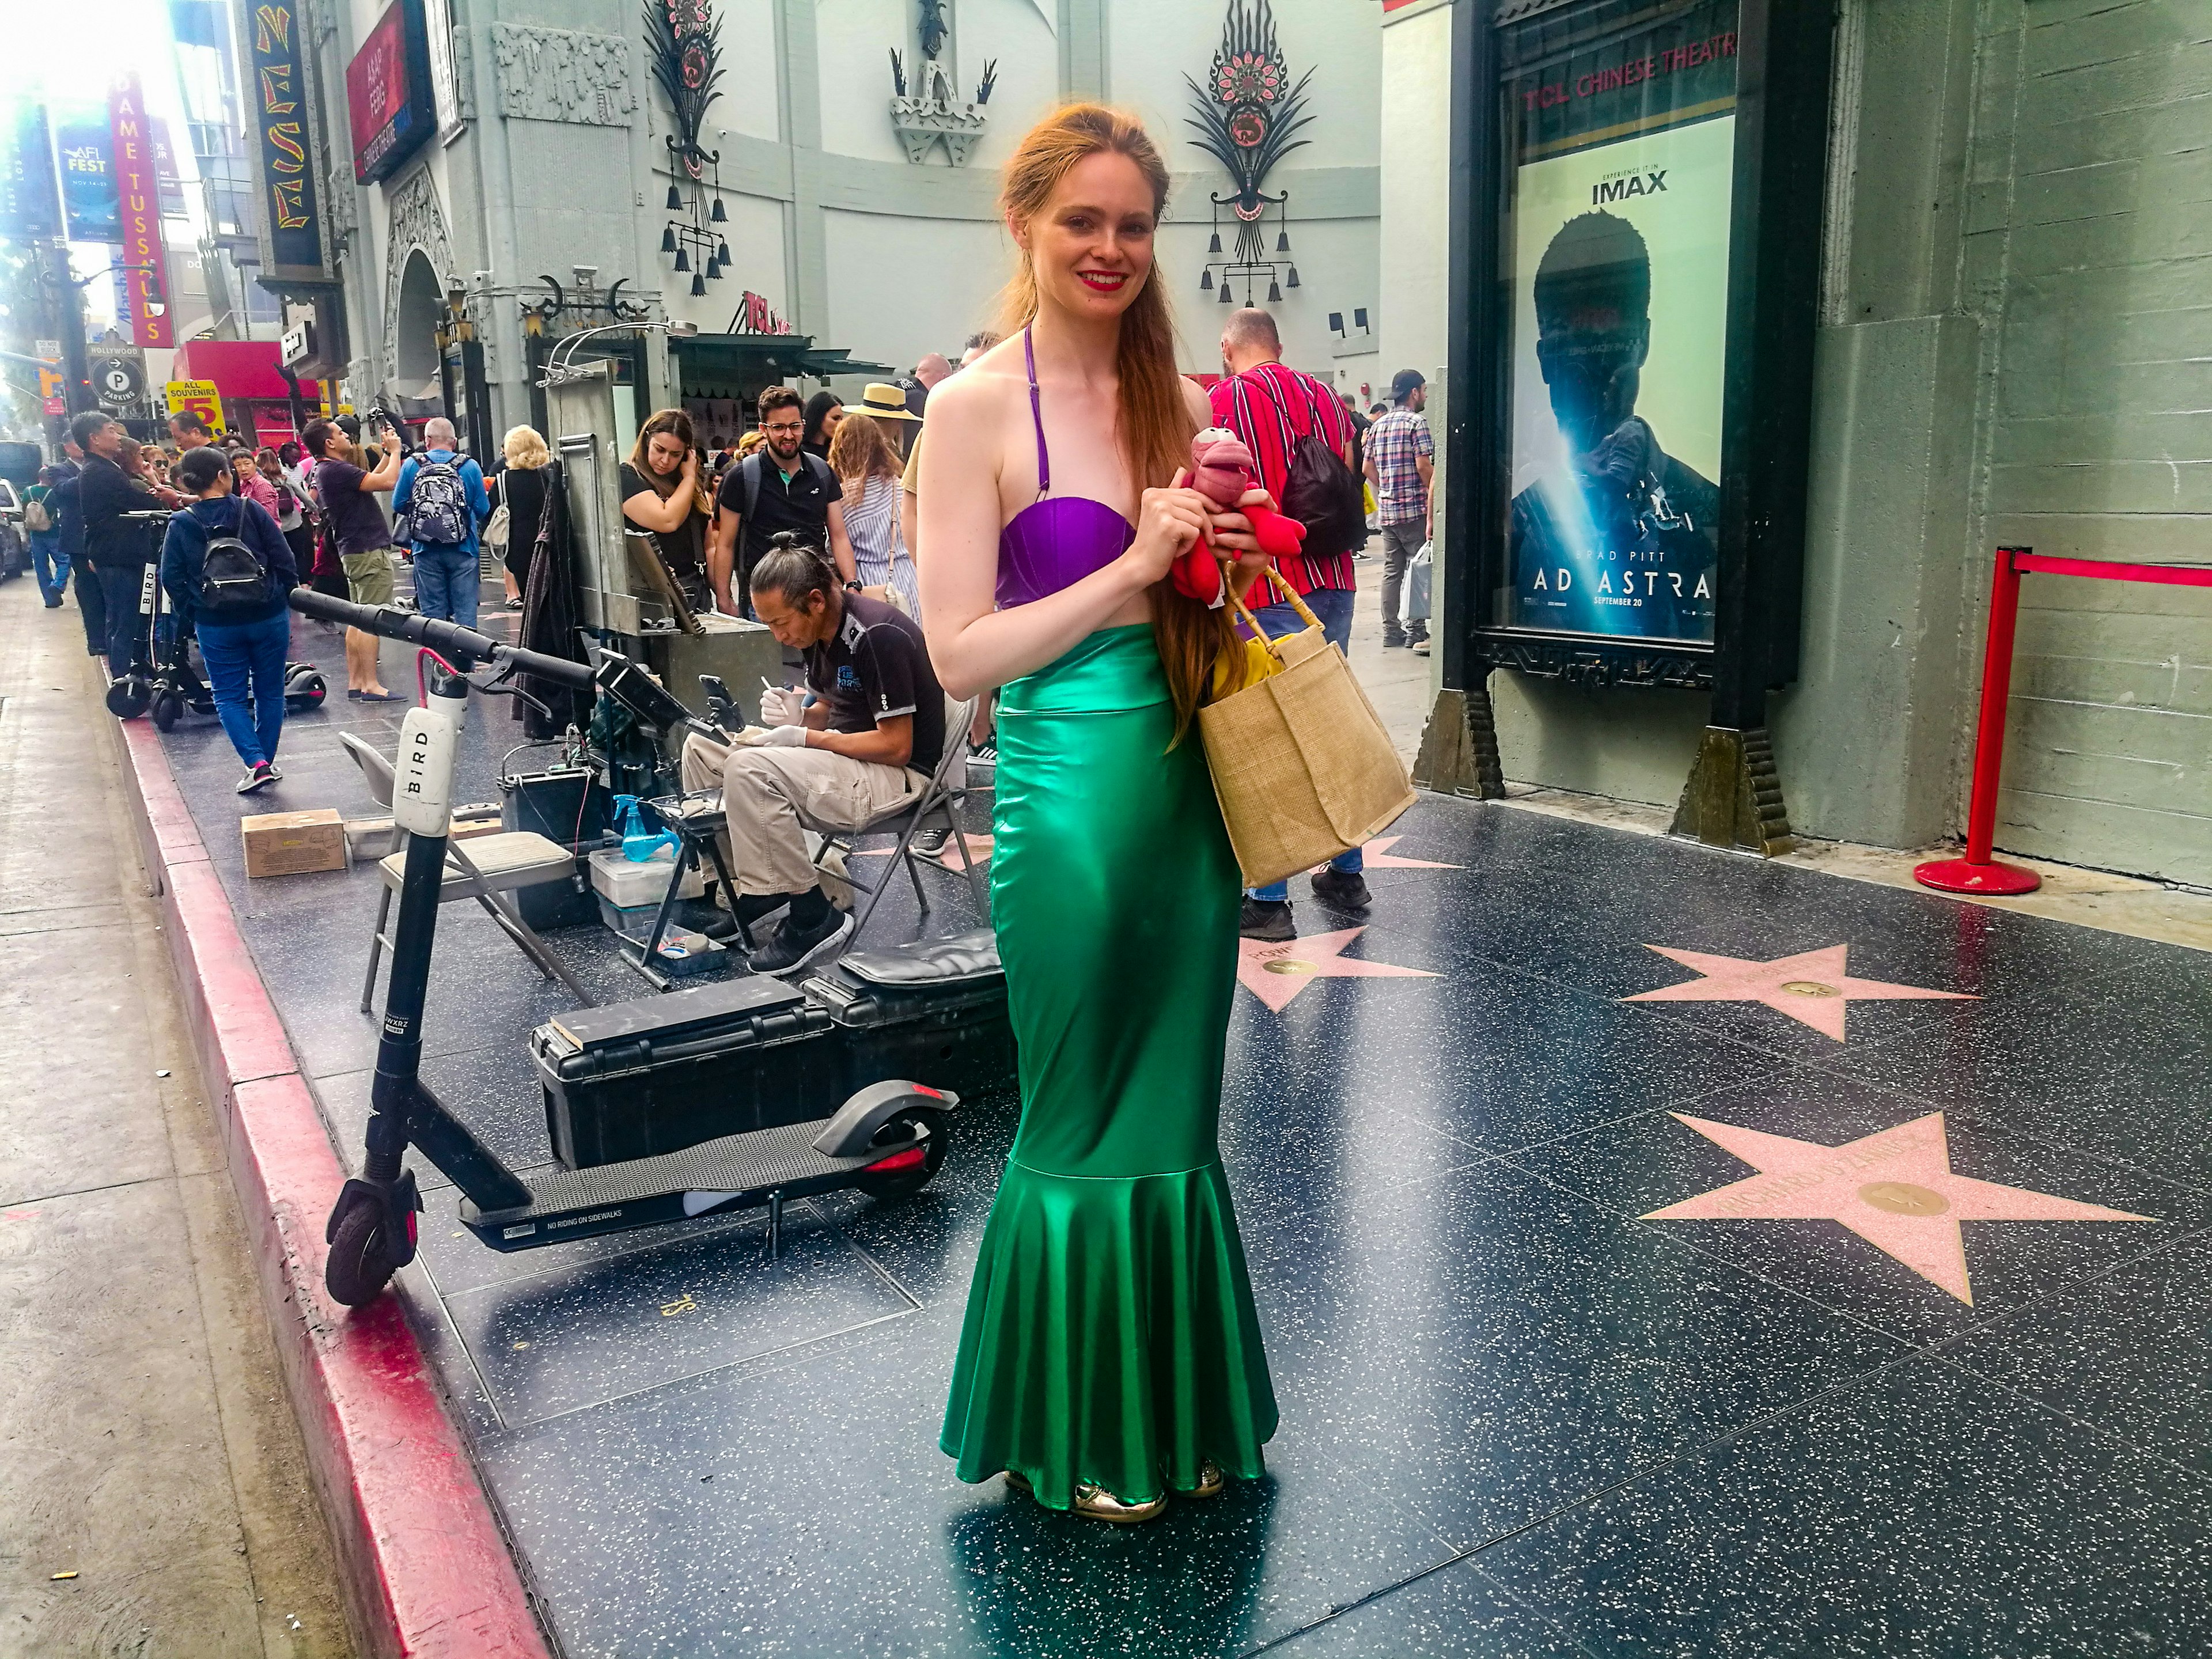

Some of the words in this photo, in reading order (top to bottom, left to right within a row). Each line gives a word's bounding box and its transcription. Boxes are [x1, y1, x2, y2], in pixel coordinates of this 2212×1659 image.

[1522, 82, 1570, 111] TCL
[1576, 56, 1656, 97] CHINESE
[370, 79, 385, 118] FERG
[70, 146, 99, 159] AFI
[68, 158, 105, 172] FEST
[1603, 166, 1640, 180] EXPERIENCE
[1592, 169, 1668, 205] IMAX
[743, 291, 772, 335] TCL
[91, 347, 138, 355] HOLLYWOOD
[113, 374, 123, 388] P
[104, 390, 135, 401] PARKING
[171, 389, 216, 397] SOUVENIRS
[1576, 551, 1616, 561] BRAD
[1630, 552, 1665, 562] PITT
[143, 573, 154, 604] BIRD
[1533, 567, 1571, 592] AD
[1597, 569, 1711, 599] ASTRA
[1594, 597, 1631, 606] SEPTEMBER
[1633, 598, 1642, 607] 20
[407, 732, 428, 794] BIRD
[547, 1222, 556, 1230] NO
[558, 1218, 577, 1228] RIDING
[578, 1216, 588, 1225] ON
[588, 1210, 622, 1222] SIDEWALKS
